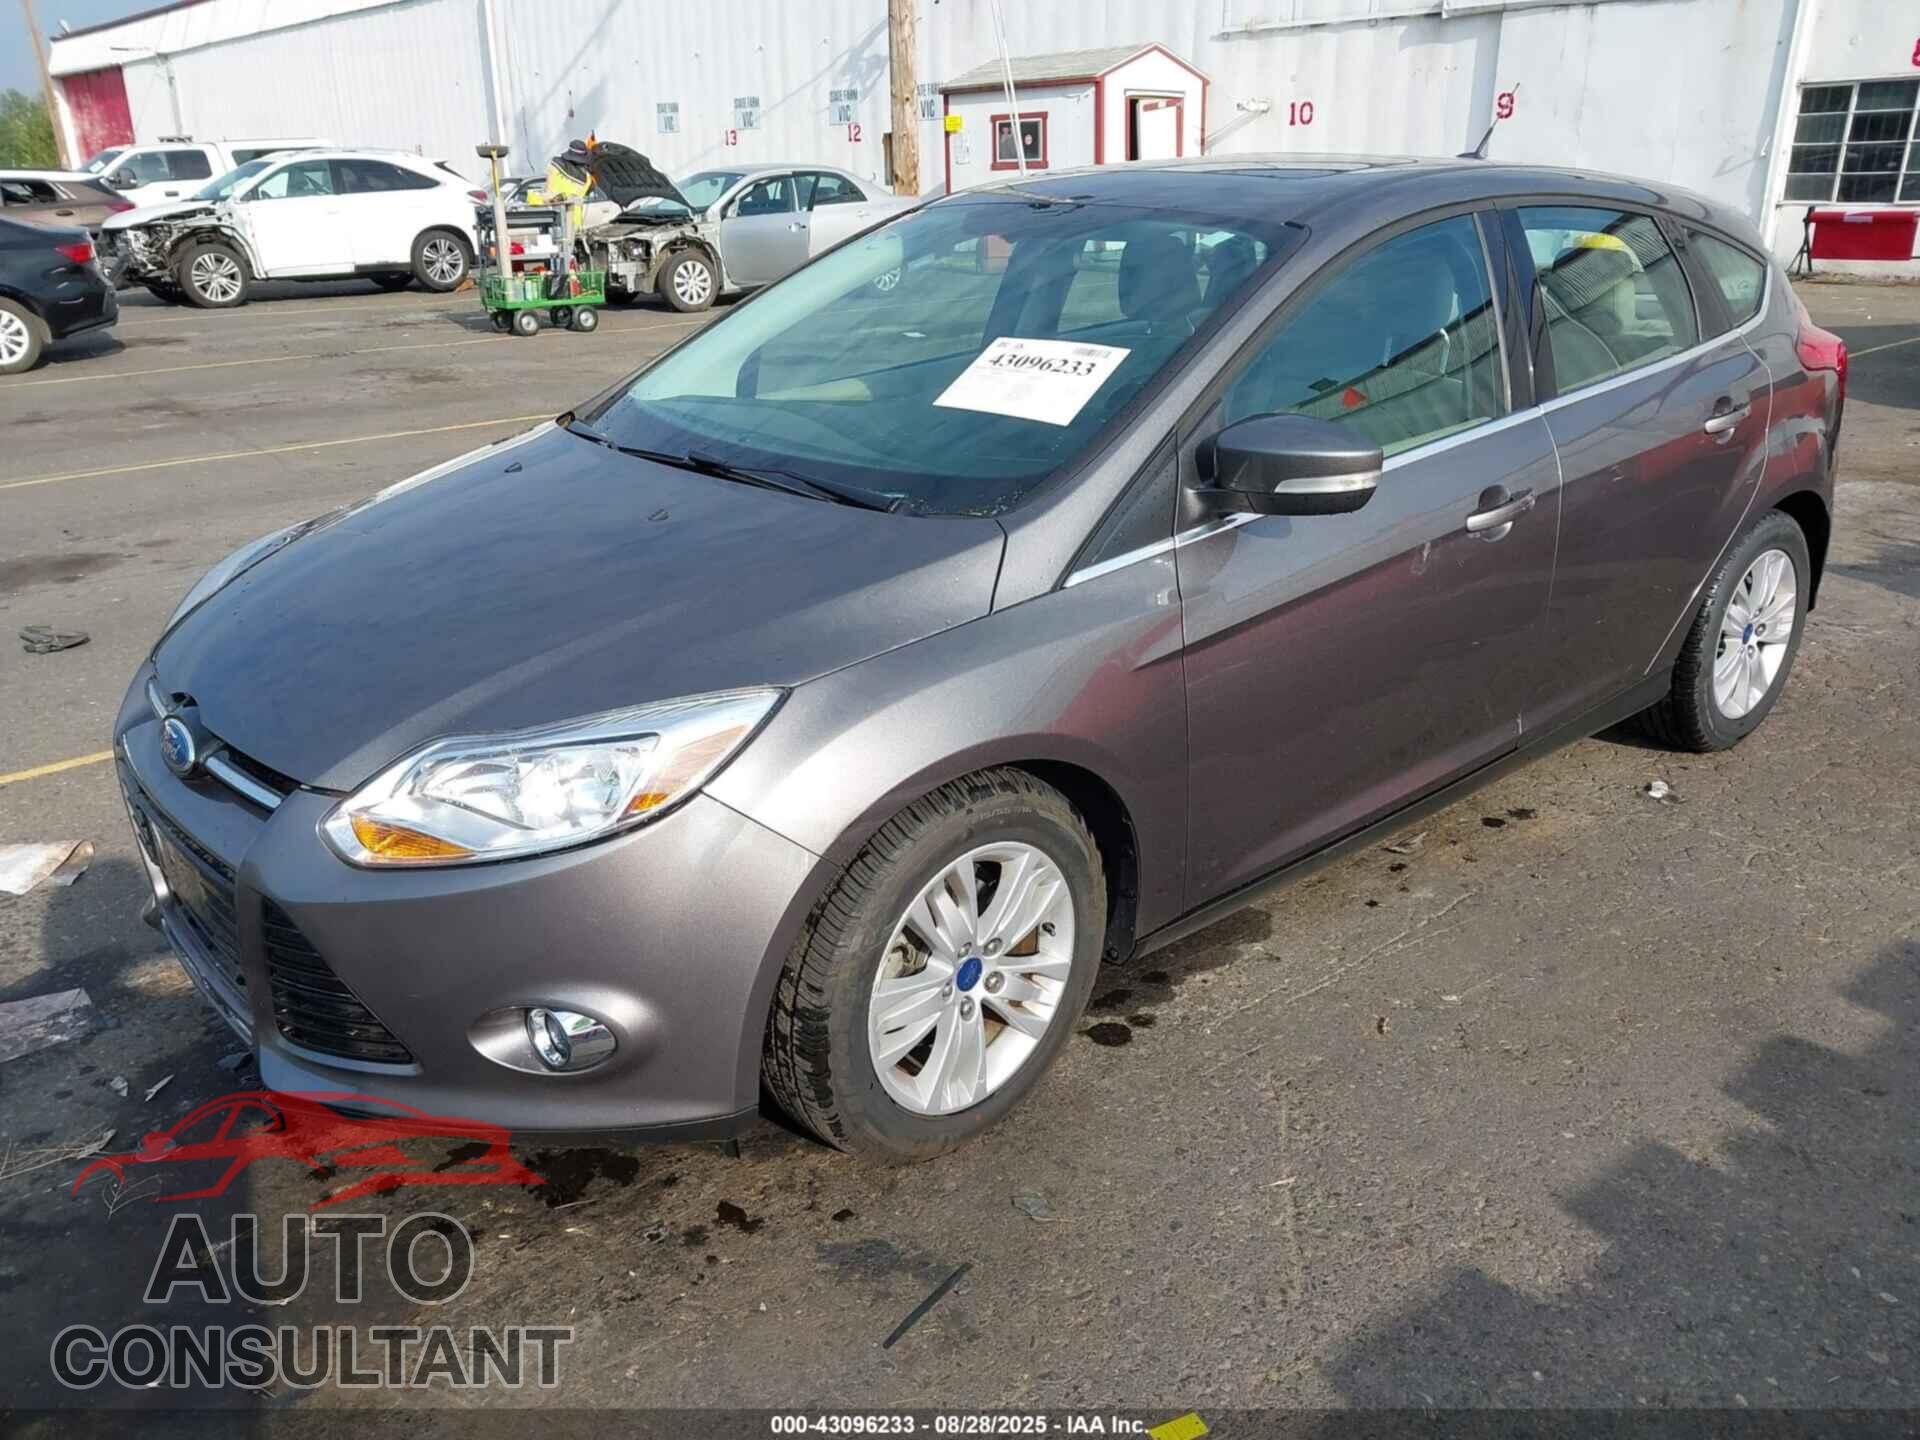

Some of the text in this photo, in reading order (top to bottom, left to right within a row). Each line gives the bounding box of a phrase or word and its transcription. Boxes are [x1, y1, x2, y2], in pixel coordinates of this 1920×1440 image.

[838, 105, 851, 122] VIC
[920, 99, 935, 118] VIC
[1289, 101, 1314, 126] 10
[1496, 92, 1514, 119] 9
[742, 111, 753, 127] VIC
[725, 130, 737, 146] 13
[847, 123, 862, 142] 12
[988, 352, 1097, 377] 43096233
